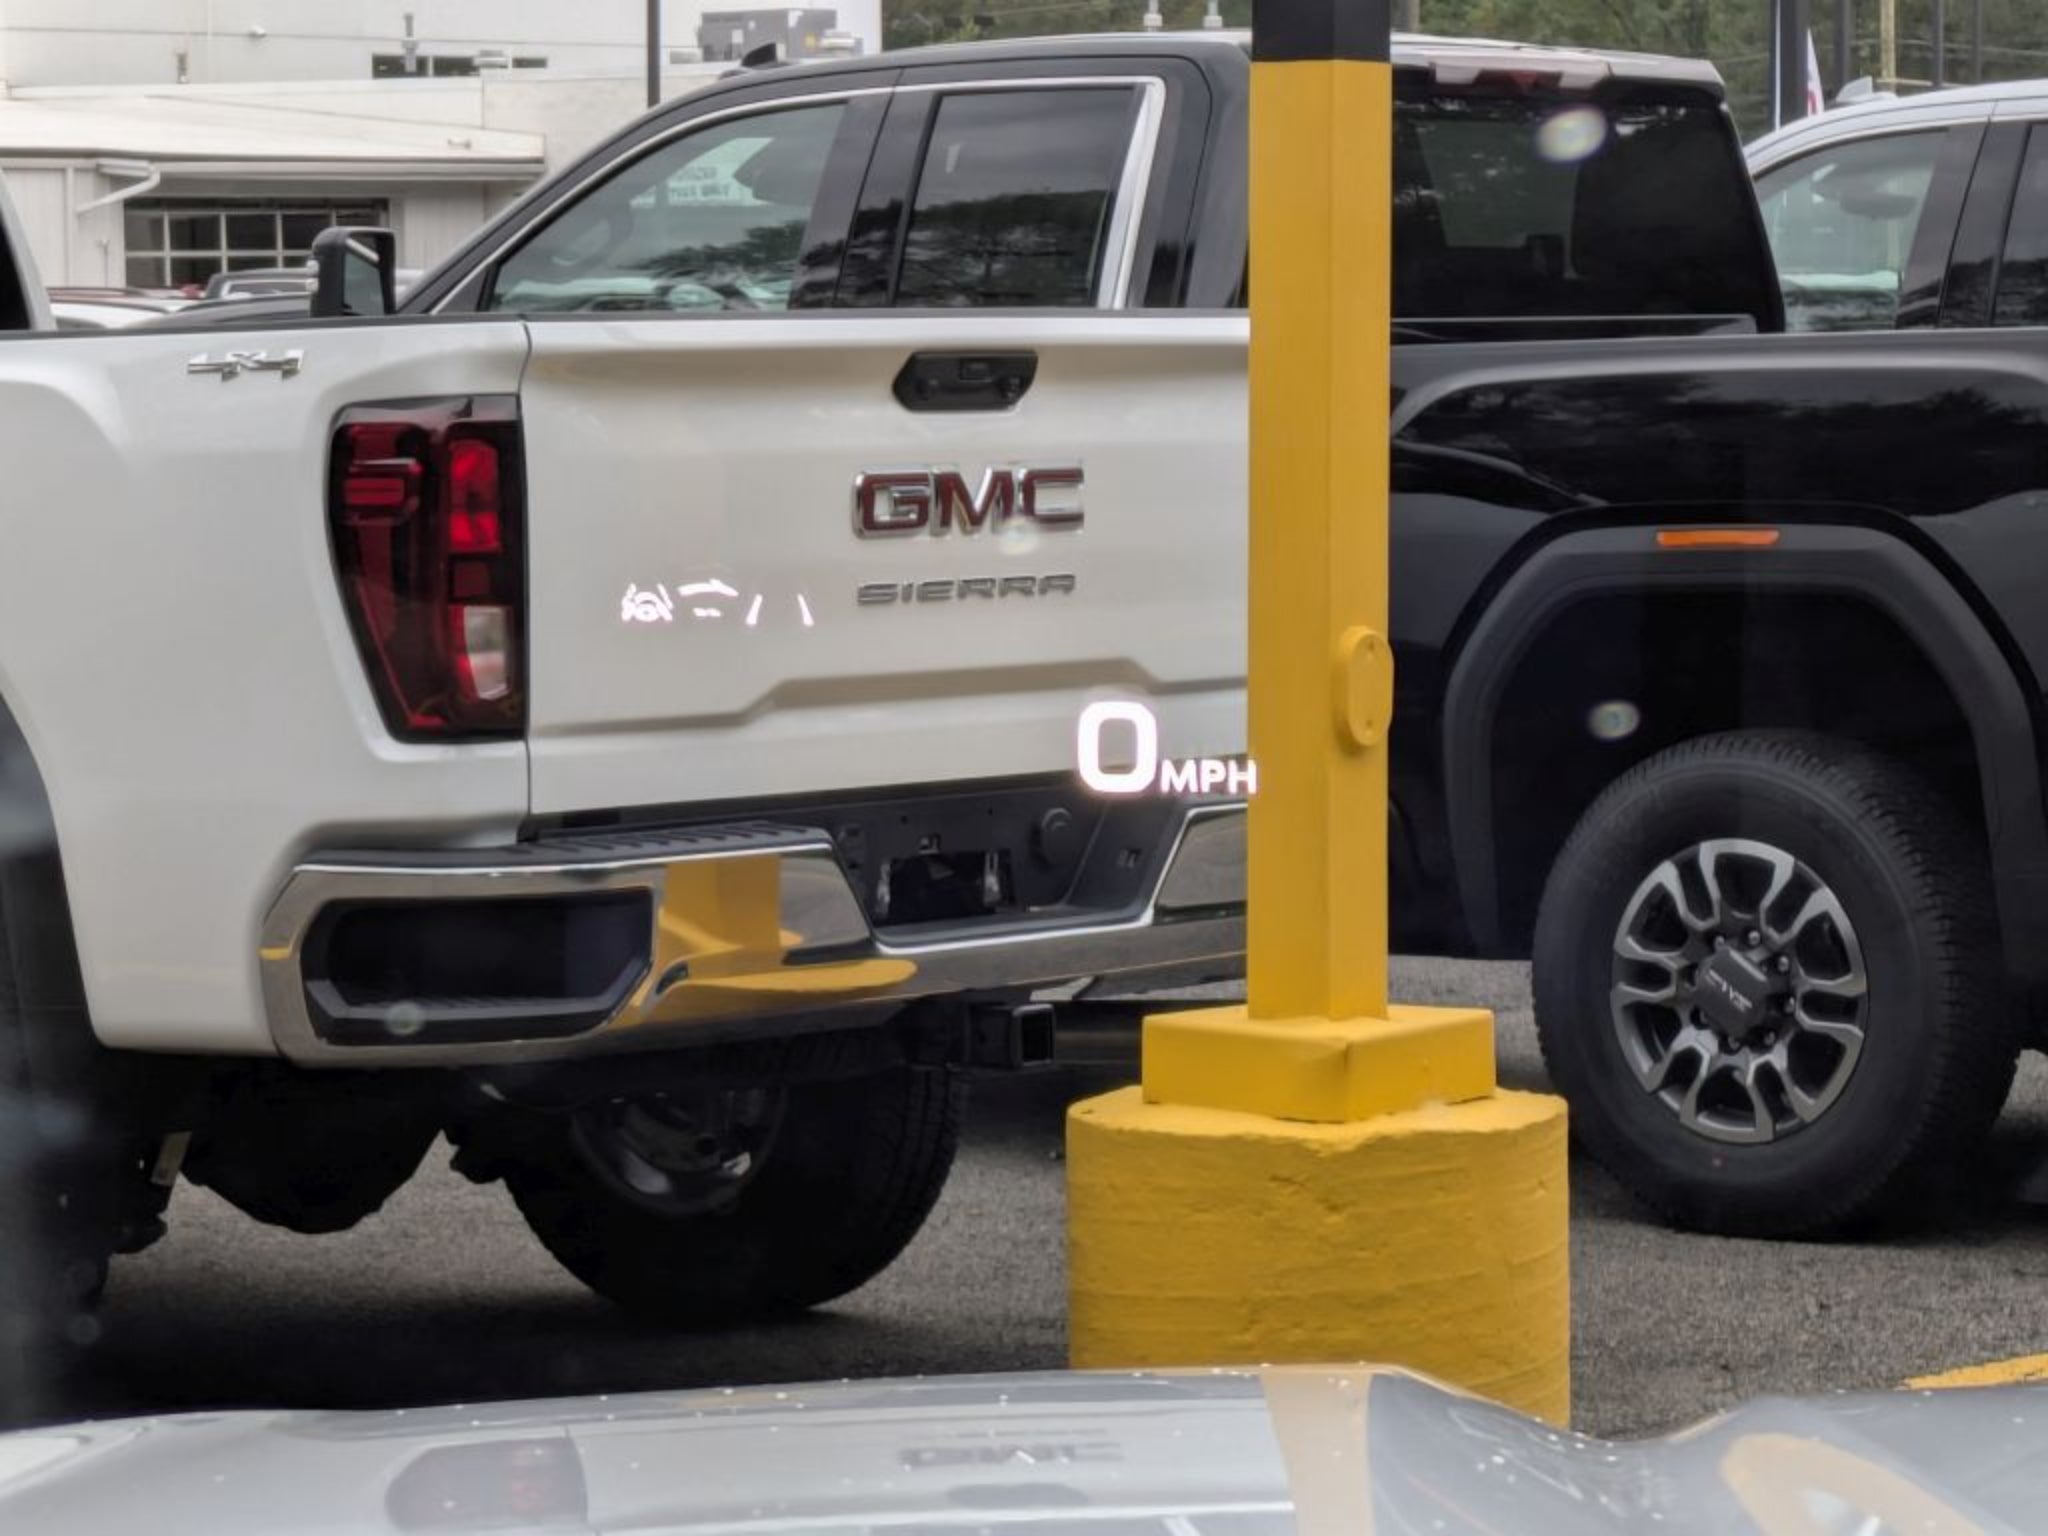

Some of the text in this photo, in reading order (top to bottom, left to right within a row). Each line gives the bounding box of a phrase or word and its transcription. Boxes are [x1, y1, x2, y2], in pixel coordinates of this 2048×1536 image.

[853, 464, 1084, 540] GMC
[857, 574, 1075, 606] SIERRA
[1077, 701, 1257, 794] 0 MPH
